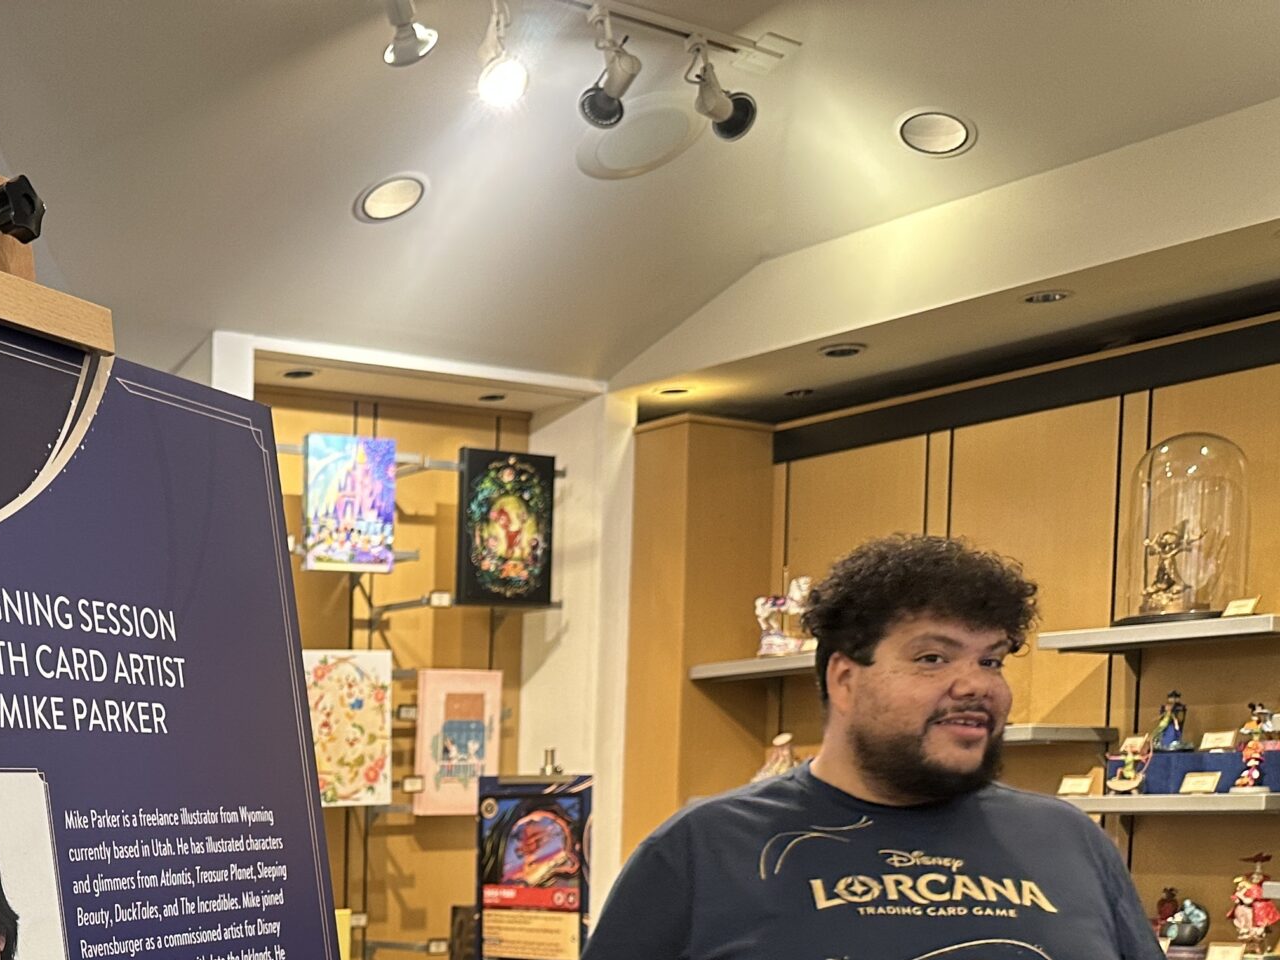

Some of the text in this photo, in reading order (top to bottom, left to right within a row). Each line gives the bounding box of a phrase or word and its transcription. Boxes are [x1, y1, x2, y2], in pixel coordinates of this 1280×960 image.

[78, 599, 177, 642] SESSION
[35, 644, 108, 682] CARD
[114, 651, 185, 688] ARTIST
[0, 693, 168, 734] MIKE PARKER
[64, 805, 274, 829] Mike Parker is a freelance illustrator from Wyoming
[68, 833, 284, 864] currently based in Utah. He has illustrated characters
[878, 849, 964, 872] Disney
[72, 860, 287, 897] and glimmers from Atlantis, Treasure Planet, Sleeping
[809, 873, 1058, 913] LORCANA
[76, 887, 284, 929] Beauty, DuckTales, and The Incredibles. Mike joined
[858, 906, 1017, 918] TRADING CARD GAME
[79, 918, 281, 959] Ravensburger as a commissioned artist for Disney
[273, 944, 286, 960] He
